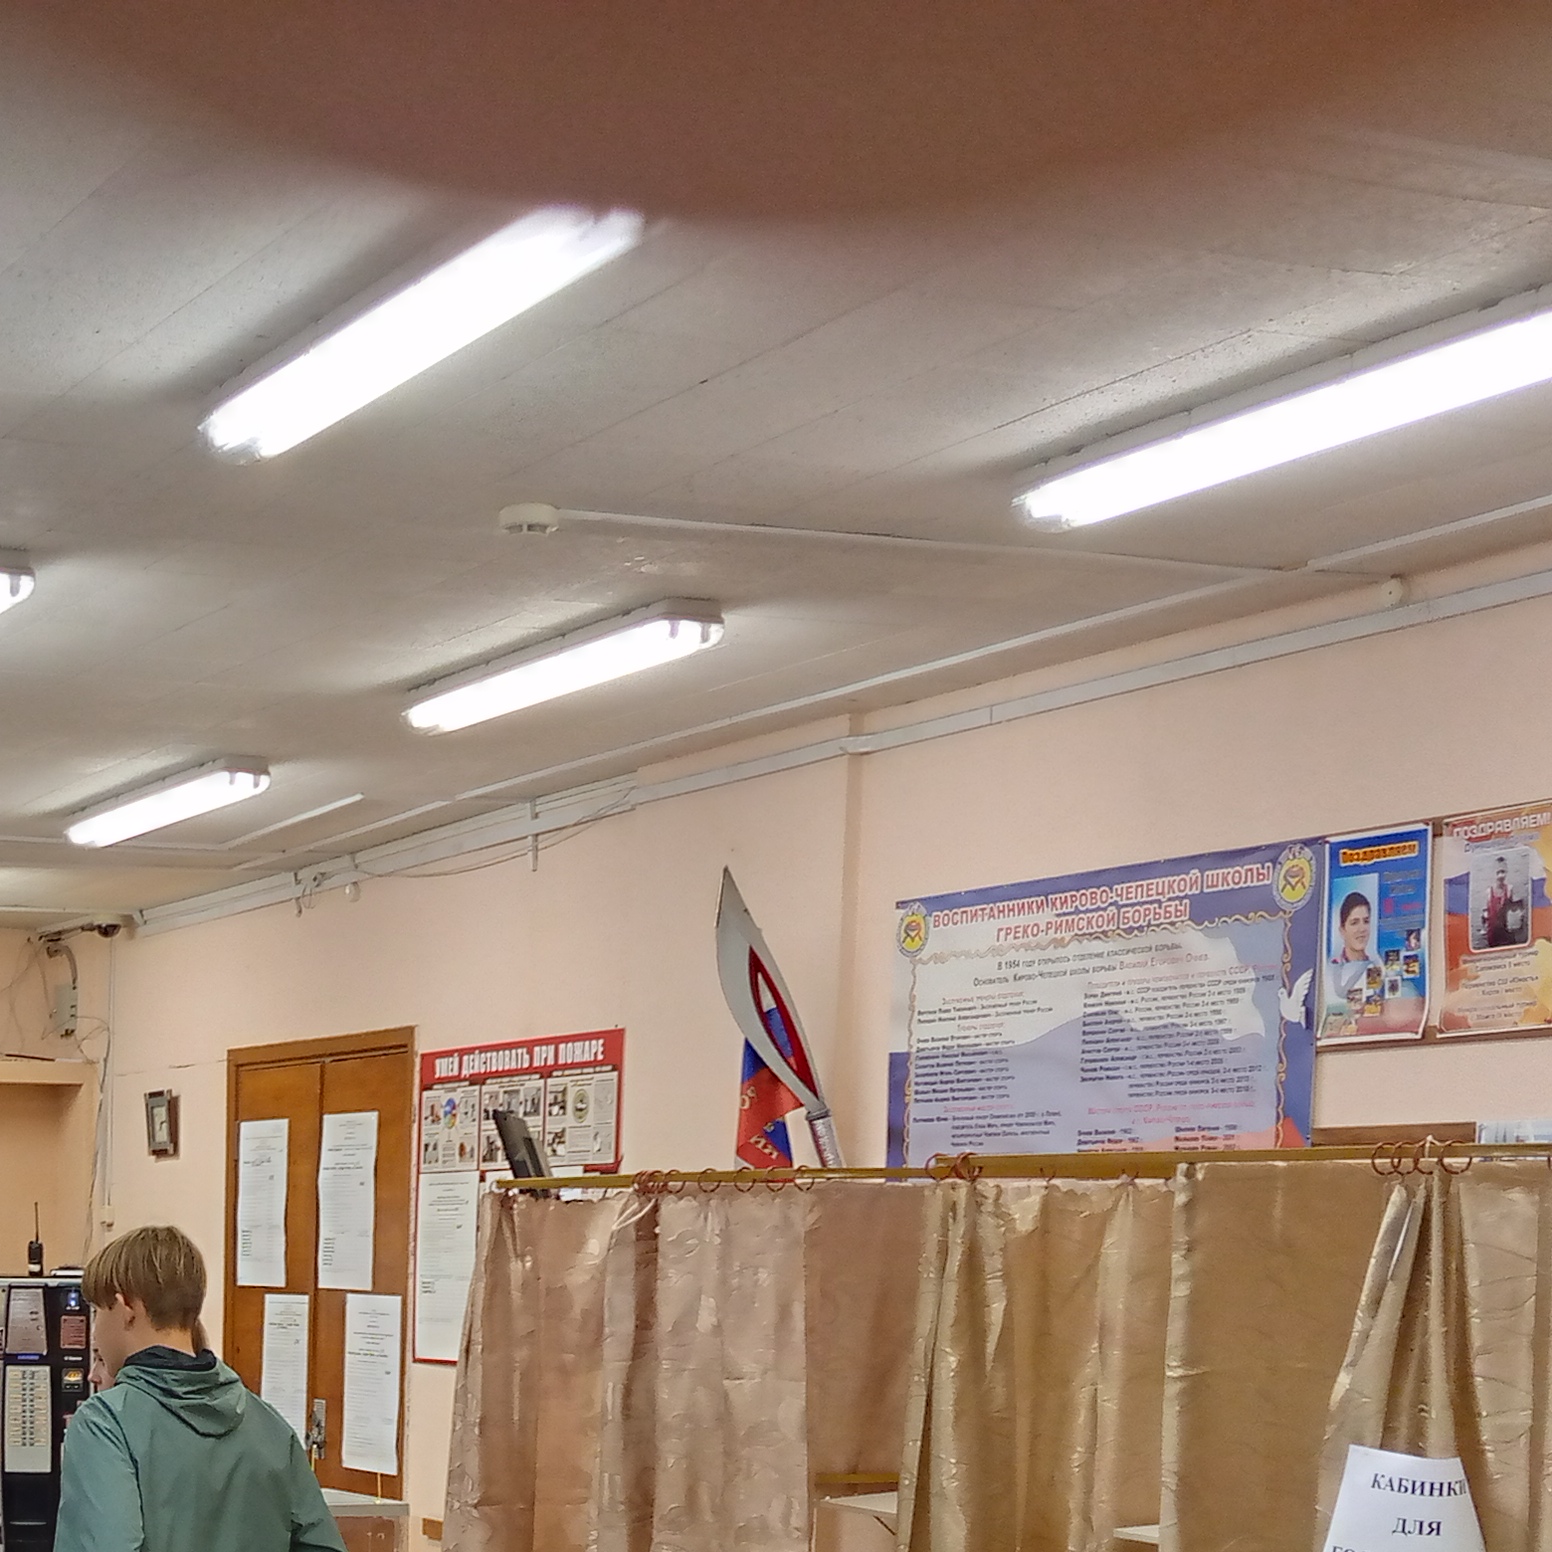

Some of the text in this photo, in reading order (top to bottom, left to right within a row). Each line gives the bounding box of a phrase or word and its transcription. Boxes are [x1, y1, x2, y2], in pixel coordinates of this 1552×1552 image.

[933, 864, 1271, 928] ВОСПИТАННИКИ КИРОВО-ЧЕПЕЦКОЙ ШКОЛЫ
[996, 901, 1189, 943] ГРЕКО-РИМСКОЙ БОРЬБЫ
[434, 1053, 459, 1078] УМЕЙ
[461, 1047, 530, 1078] ДЕЙСТВОВАТЬ
[533, 1043, 556, 1067] ПРИ
[558, 1038, 605, 1065] ПОЖАРЕ
[1371, 1473, 1466, 1497] КАБИНКИ
[1392, 1517, 1442, 1537] ДЛЯ
